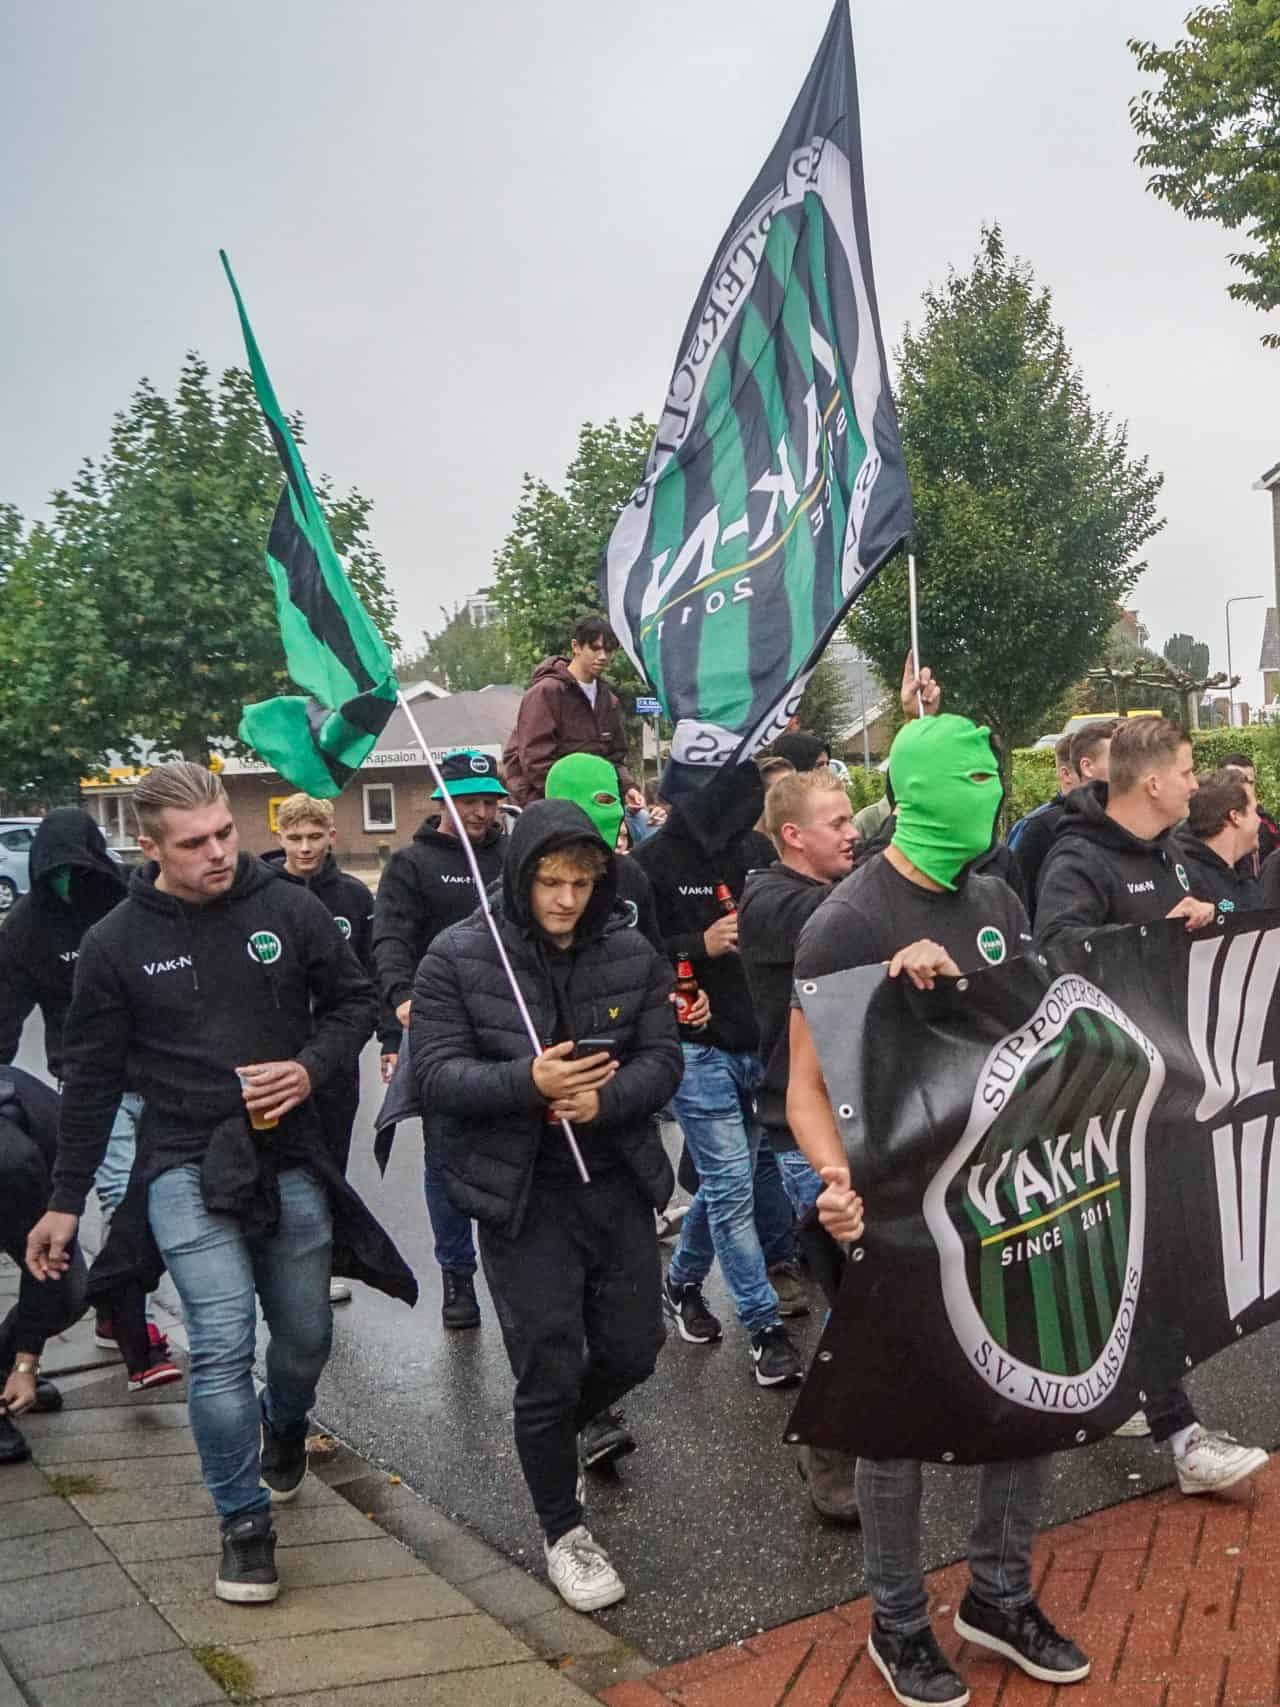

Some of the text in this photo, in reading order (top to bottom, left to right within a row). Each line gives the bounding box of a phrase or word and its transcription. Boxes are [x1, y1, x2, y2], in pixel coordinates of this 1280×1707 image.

[967, 1109, 1127, 1226] VAK-N
[1000, 1200, 1112, 1266] SINCE 2011
[1025, 1347, 1120, 1409] NICOLAAS
[1114, 1267, 1140, 1352] BOYS
